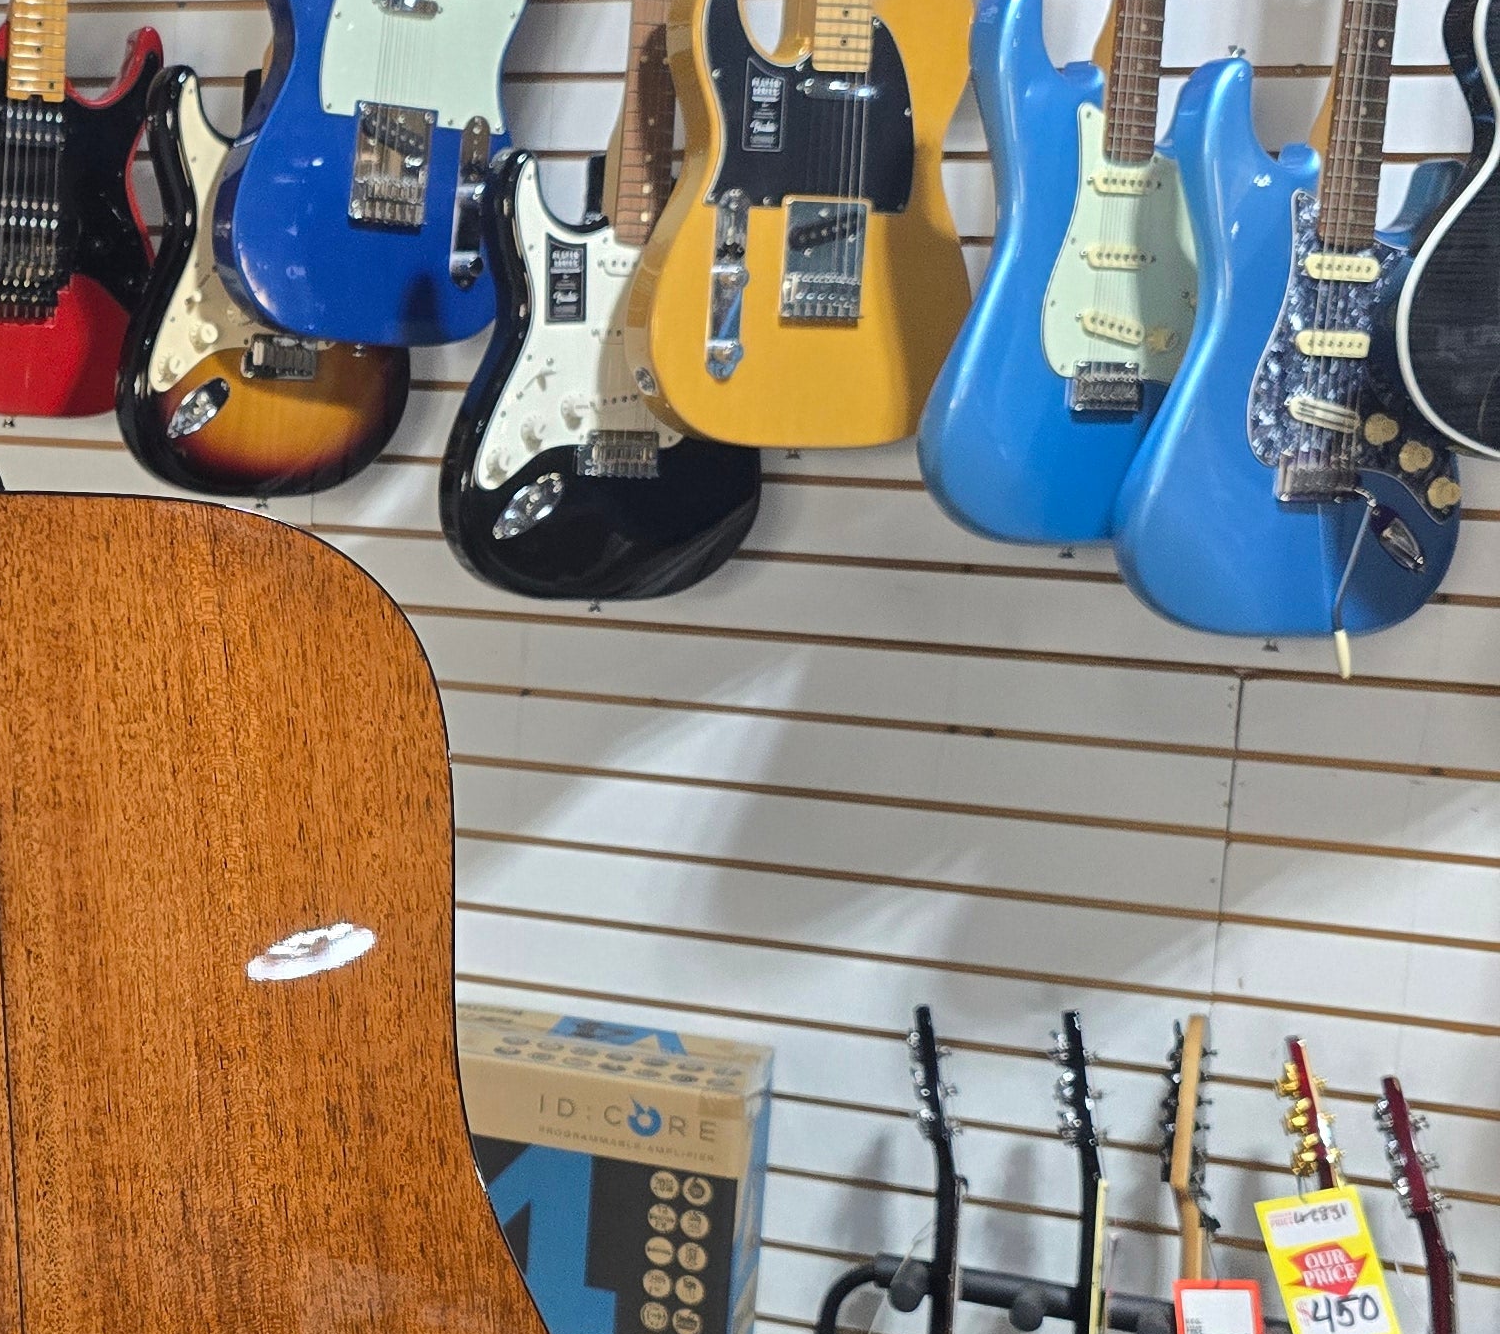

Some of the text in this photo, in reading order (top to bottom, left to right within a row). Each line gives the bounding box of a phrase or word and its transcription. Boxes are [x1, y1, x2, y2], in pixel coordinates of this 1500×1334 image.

[1304, 1248, 1348, 1269] OUR
[1302, 1263, 1358, 1288] PRICE
[1296, 1294, 1379, 1332] $450
